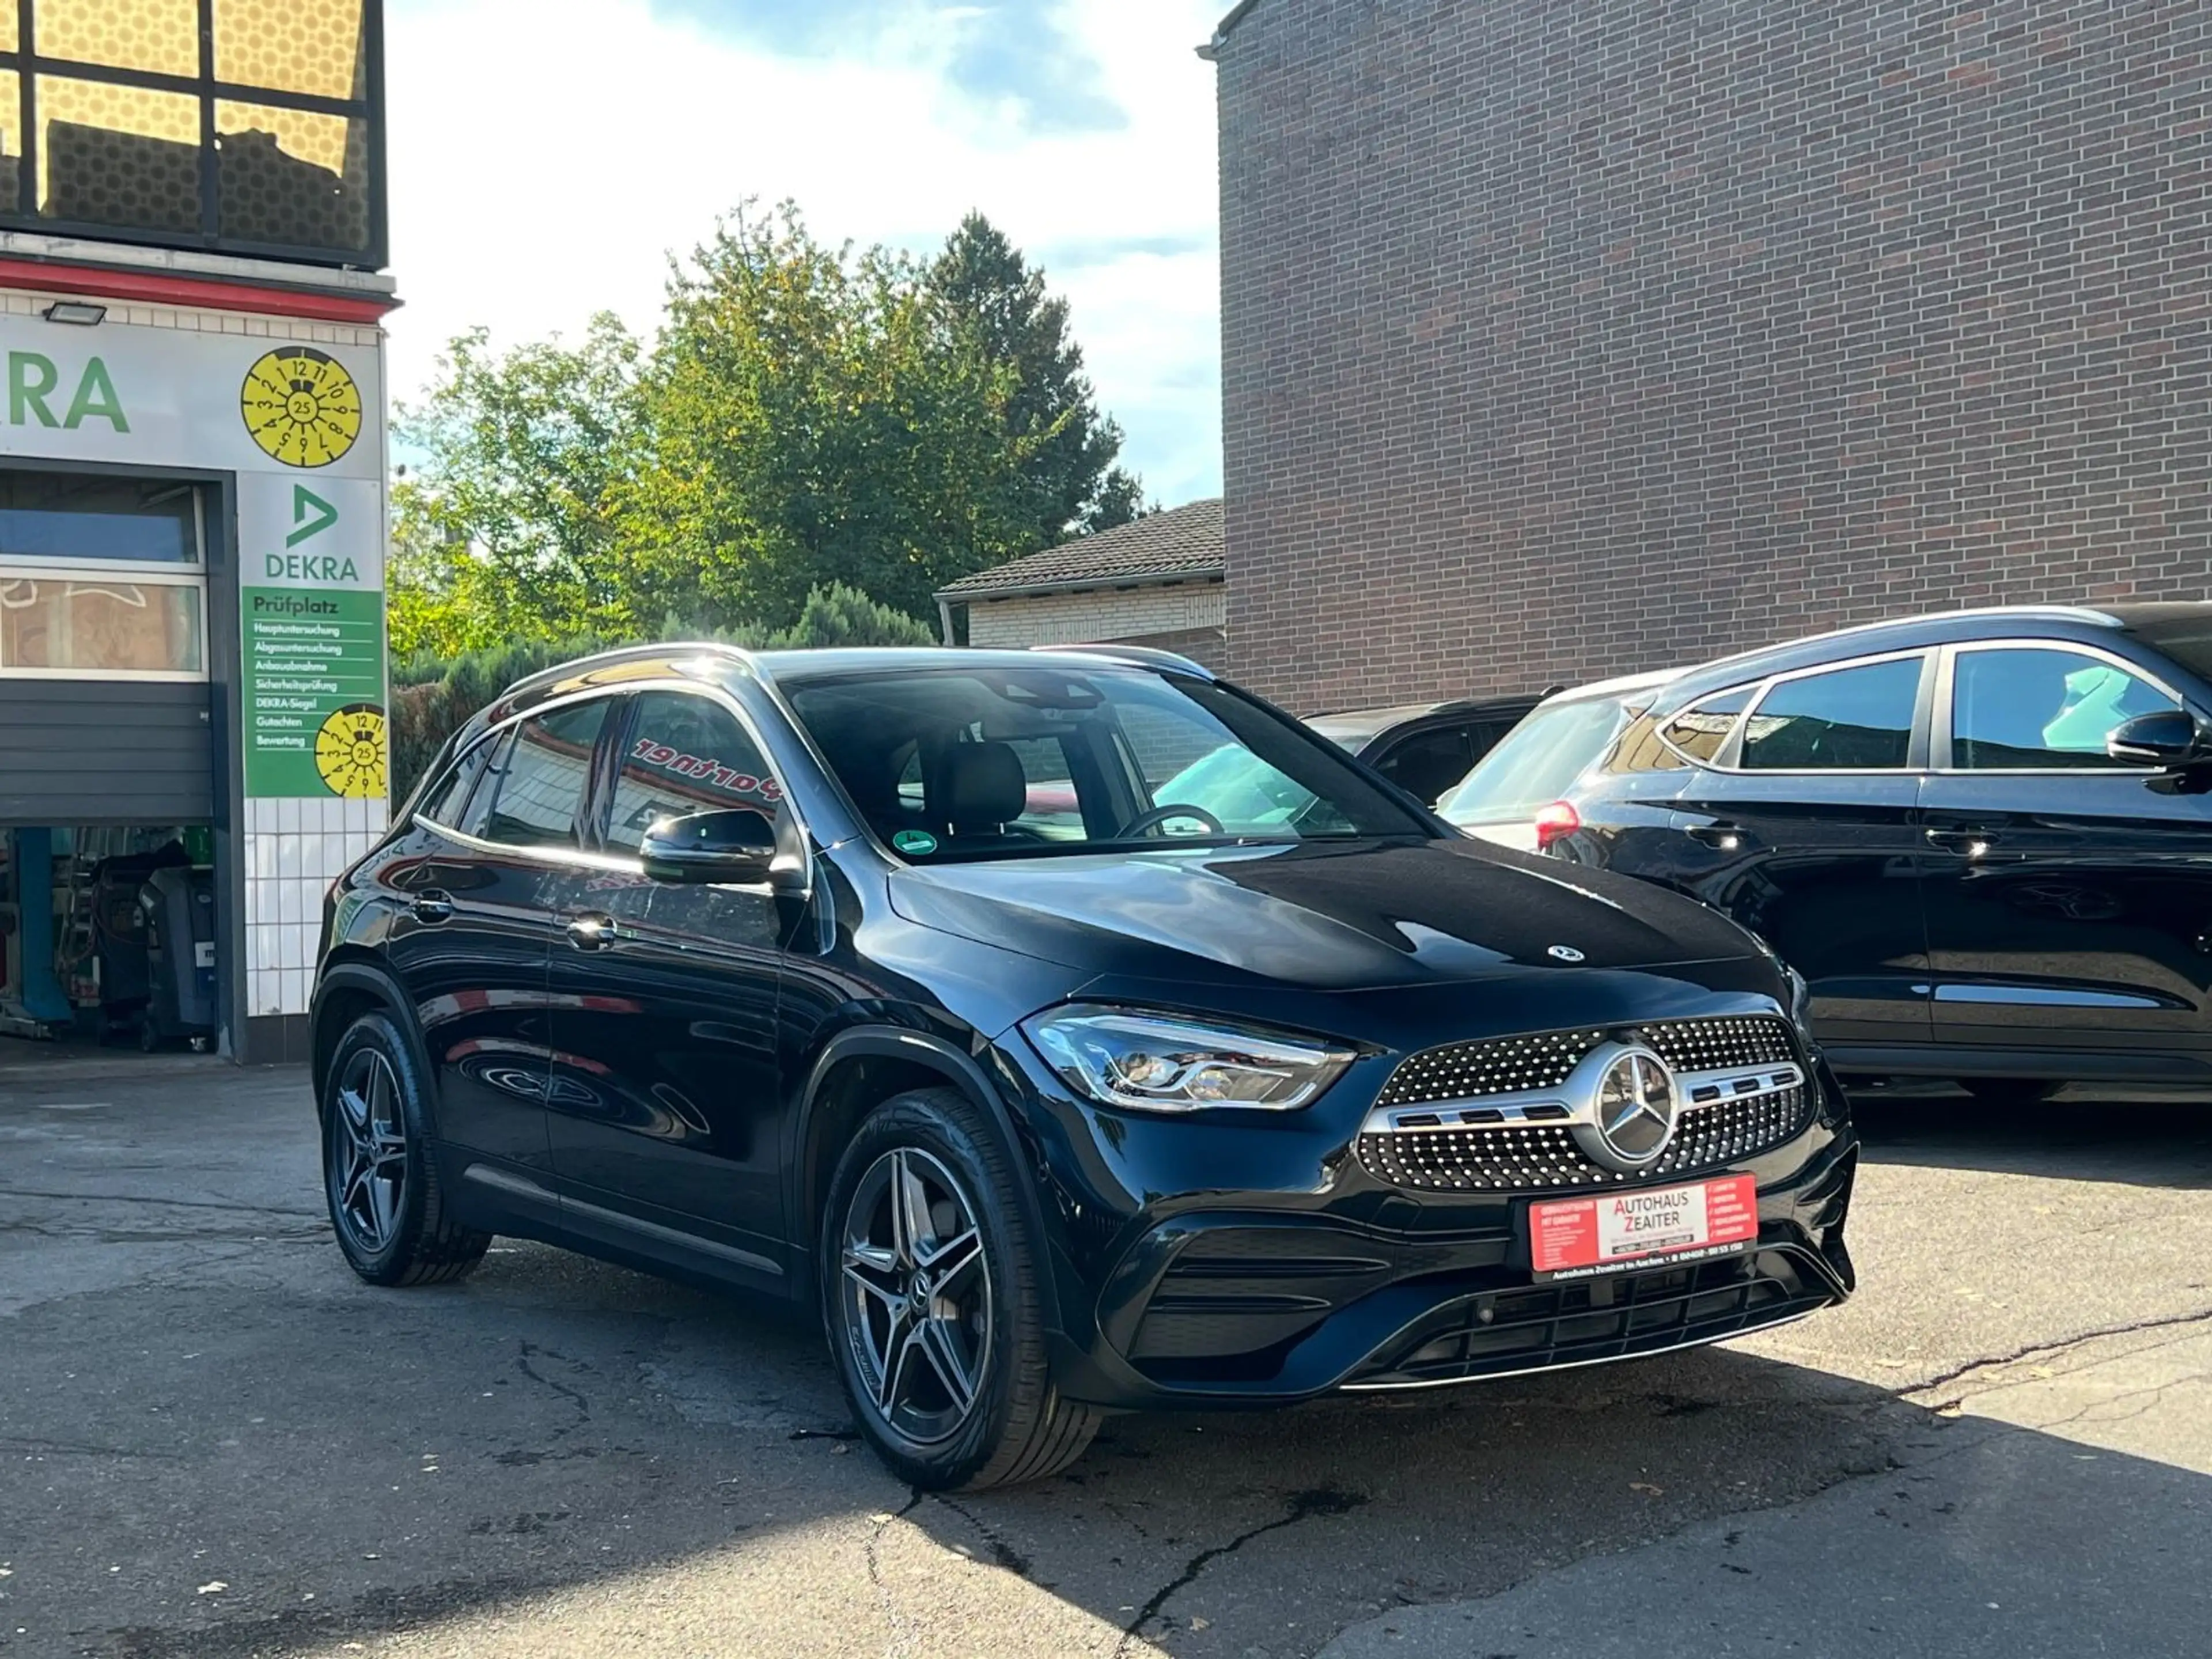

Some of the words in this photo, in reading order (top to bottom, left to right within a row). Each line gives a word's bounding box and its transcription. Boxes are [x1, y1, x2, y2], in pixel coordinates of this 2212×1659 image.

[276, 367, 287, 381] 1
[293, 361, 307, 377] 12
[313, 366, 328, 383] 11
[0, 351, 130, 433] RA
[261, 380, 277, 393] 2
[327, 381, 344, 399] 10
[257, 400, 274, 410] 3
[293, 401, 311, 415] 25
[263, 418, 278, 428] 4
[328, 422, 344, 434] 8
[279, 432, 291, 446] 5
[319, 433, 329, 449] 7
[266, 554, 359, 582] DEKRA
[253, 596, 339, 617] Prüfplatz
[254, 622, 340, 638] Hauptuntersuchung
[254, 641, 342, 656] Abgasuntersuchung
[255, 660, 327, 671] Anbauabnahme
[255, 678, 337, 693] Sicherheitsprüfung
[256, 697, 317, 711] DEKRA-Siegel
[256, 715, 302, 727] Gutachten
[343, 721, 352, 733] 1
[355, 715, 368, 728] 12
[373, 718, 384, 733] 11
[257, 735, 305, 748] Bewertung
[331, 732, 344, 745] 2
[327, 750, 341, 758] 3
[357, 748, 372, 759] 25
[332, 764, 344, 772] 4
[344, 774, 355, 787] 5
[1615, 1192, 1689, 1215] AUTOHAUS
[1624, 1211, 1680, 1232] ZEAITER
